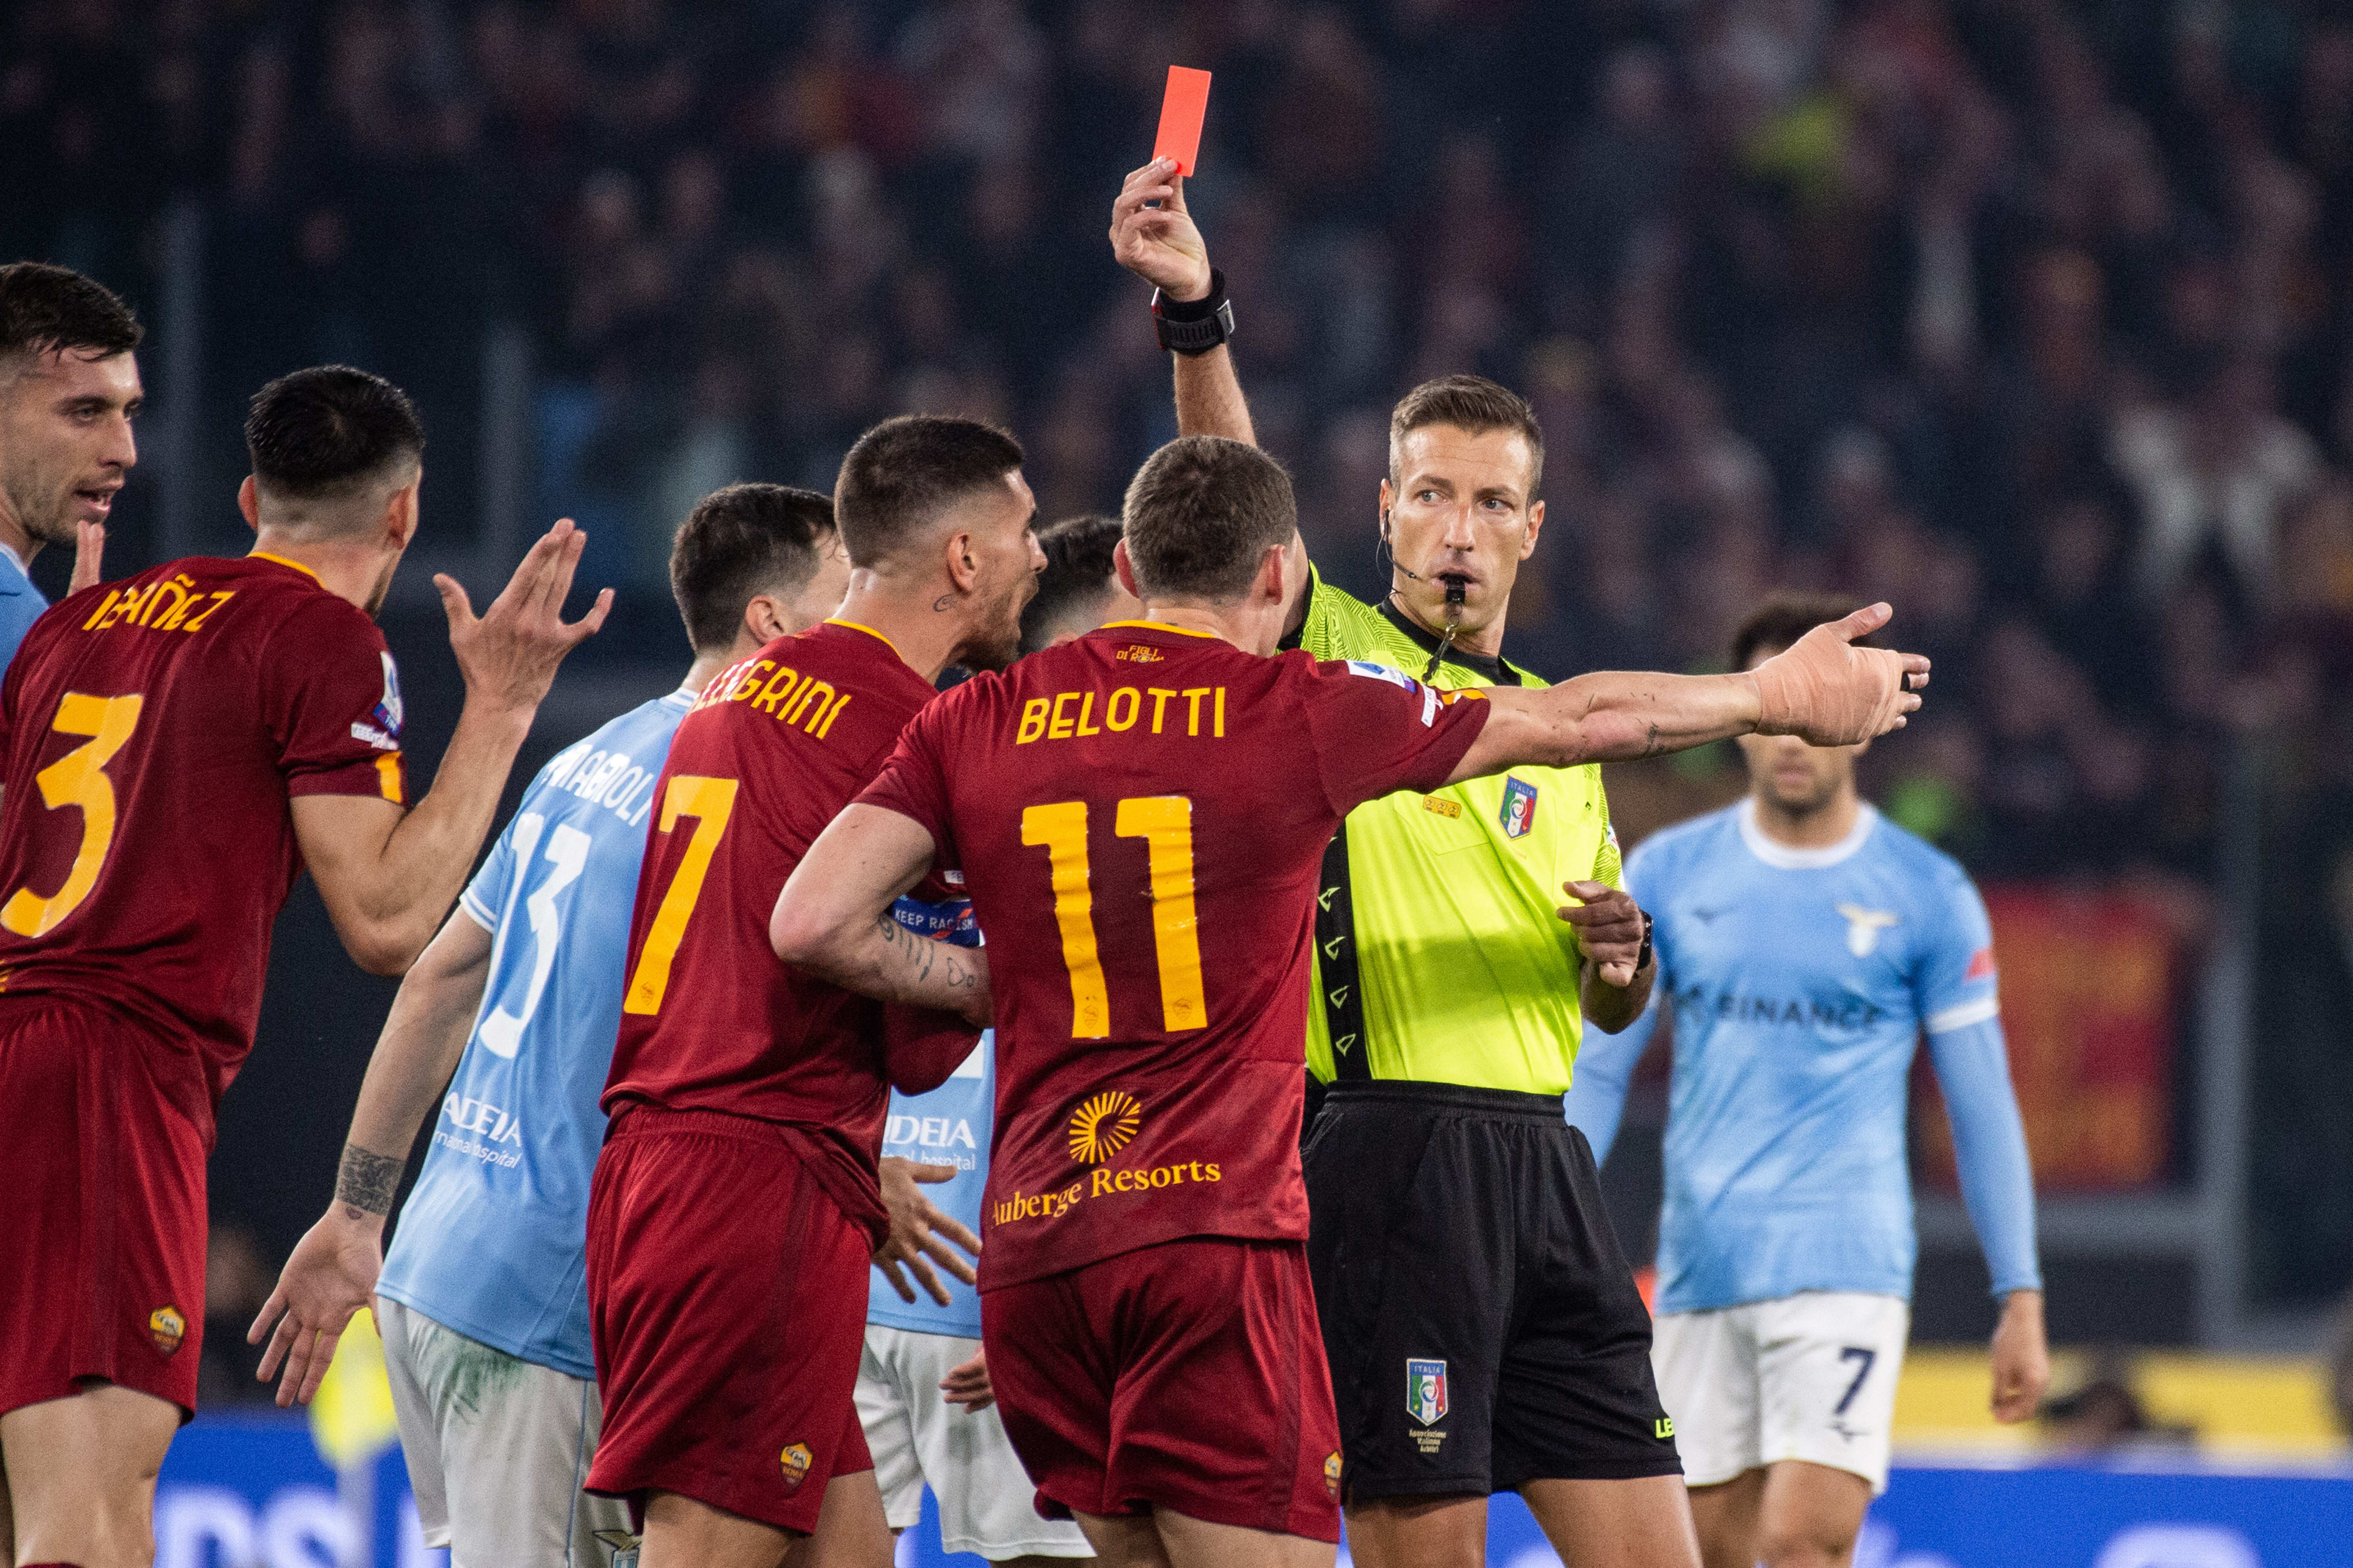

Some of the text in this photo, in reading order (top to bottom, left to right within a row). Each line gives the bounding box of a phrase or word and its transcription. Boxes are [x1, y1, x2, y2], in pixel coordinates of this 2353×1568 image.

[82, 573, 235, 632] IBAÑEZ
[1116, 650, 1128, 660] DI
[1016, 687, 1225, 745] BELOTTI
[1, 692, 144, 938] 3
[1510, 782, 1534, 796] ITALIA
[624, 775, 739, 1015] 7
[894, 909, 924, 926] KEEP
[1021, 795, 1207, 1039] 11
[468, 812, 592, 1057] 13
[992, 1160, 1221, 1229] Auberge Resorts
[1414, 1365, 1441, 1374] ITALIA
[1834, 1347, 1877, 1415] 7
